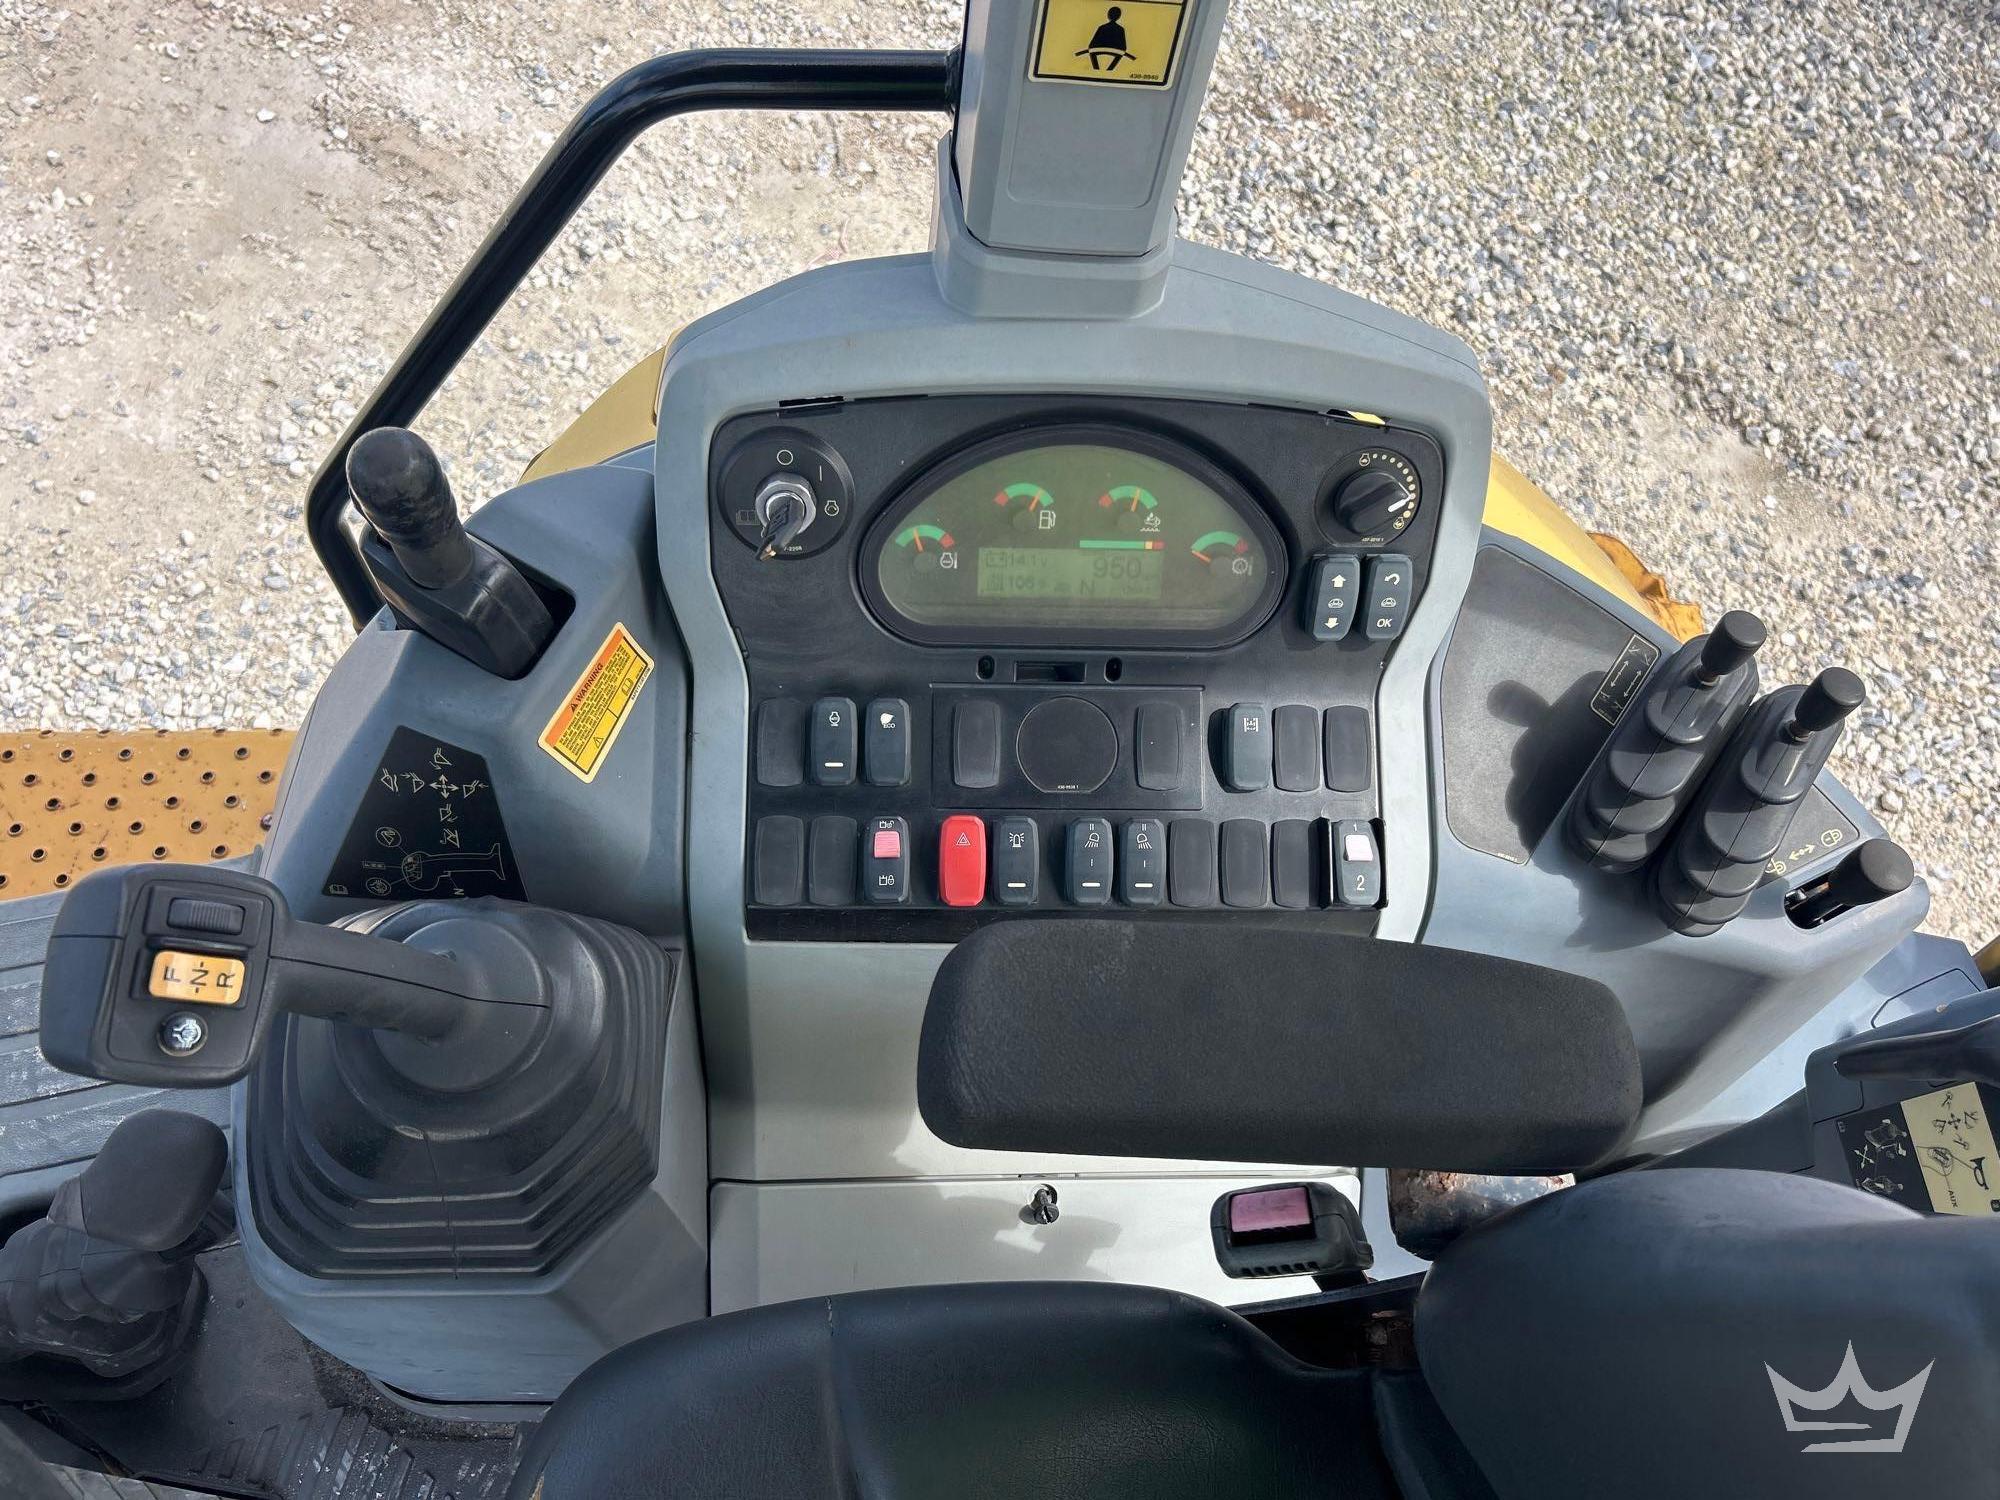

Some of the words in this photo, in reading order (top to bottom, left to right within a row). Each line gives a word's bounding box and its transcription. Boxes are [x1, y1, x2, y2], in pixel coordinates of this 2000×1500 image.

[1092, 556, 1142, 580] 950
[1376, 618, 1393, 628] OK
[575, 662, 604, 702] WARNING
[1352, 822, 1358, 832] 1
[1356, 874, 1366, 891] 2
[163, 966, 182, 983] F
[216, 972, 236, 989] R
